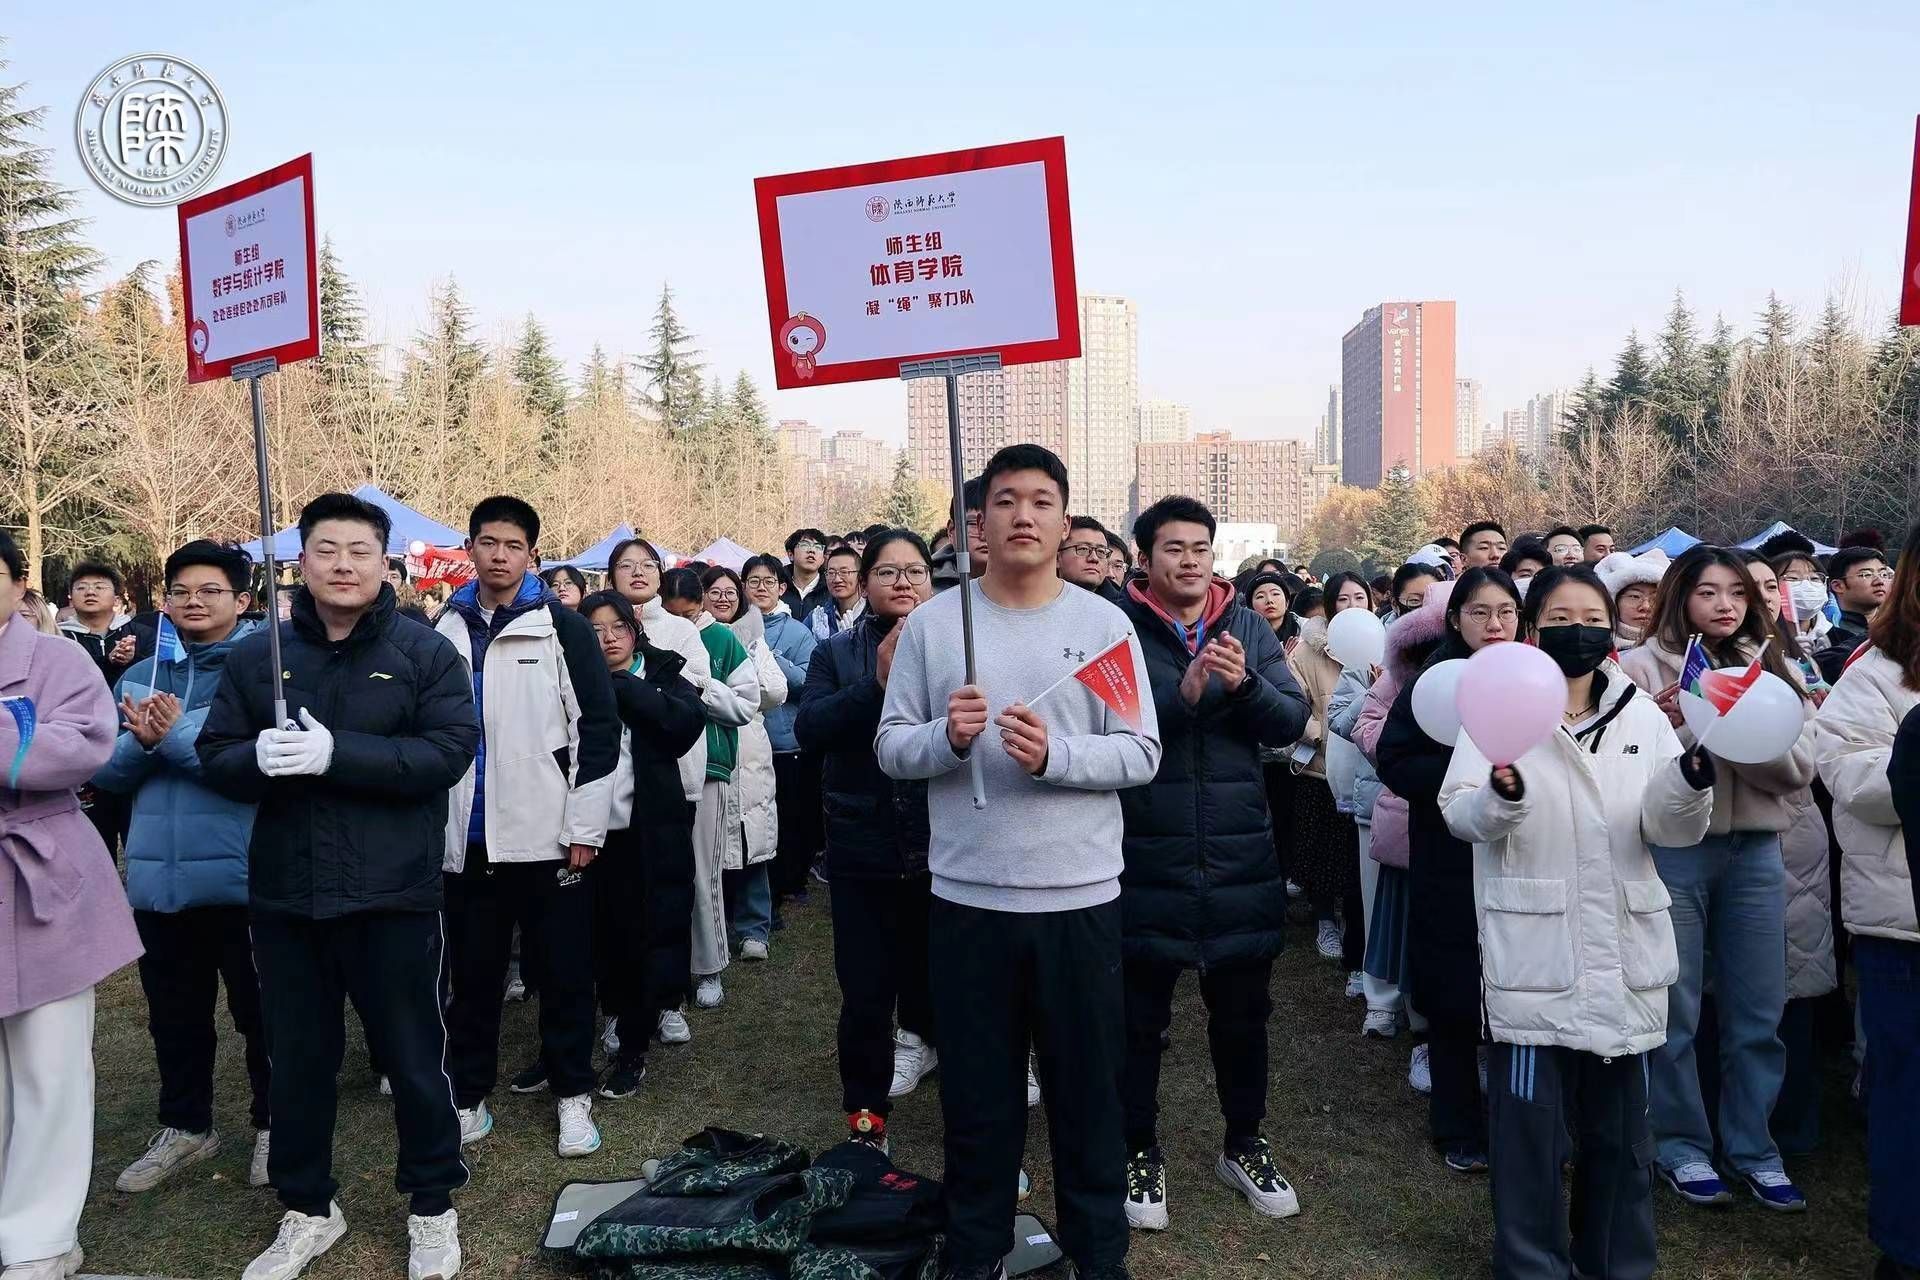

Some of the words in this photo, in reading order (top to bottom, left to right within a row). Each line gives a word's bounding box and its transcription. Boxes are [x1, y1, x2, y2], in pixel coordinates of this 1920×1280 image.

[233, 243, 261, 267] 师生组
[886, 231, 942, 256] 师生组
[212, 258, 285, 298] 数学与统计学院
[869, 254, 964, 287] 体育学院
